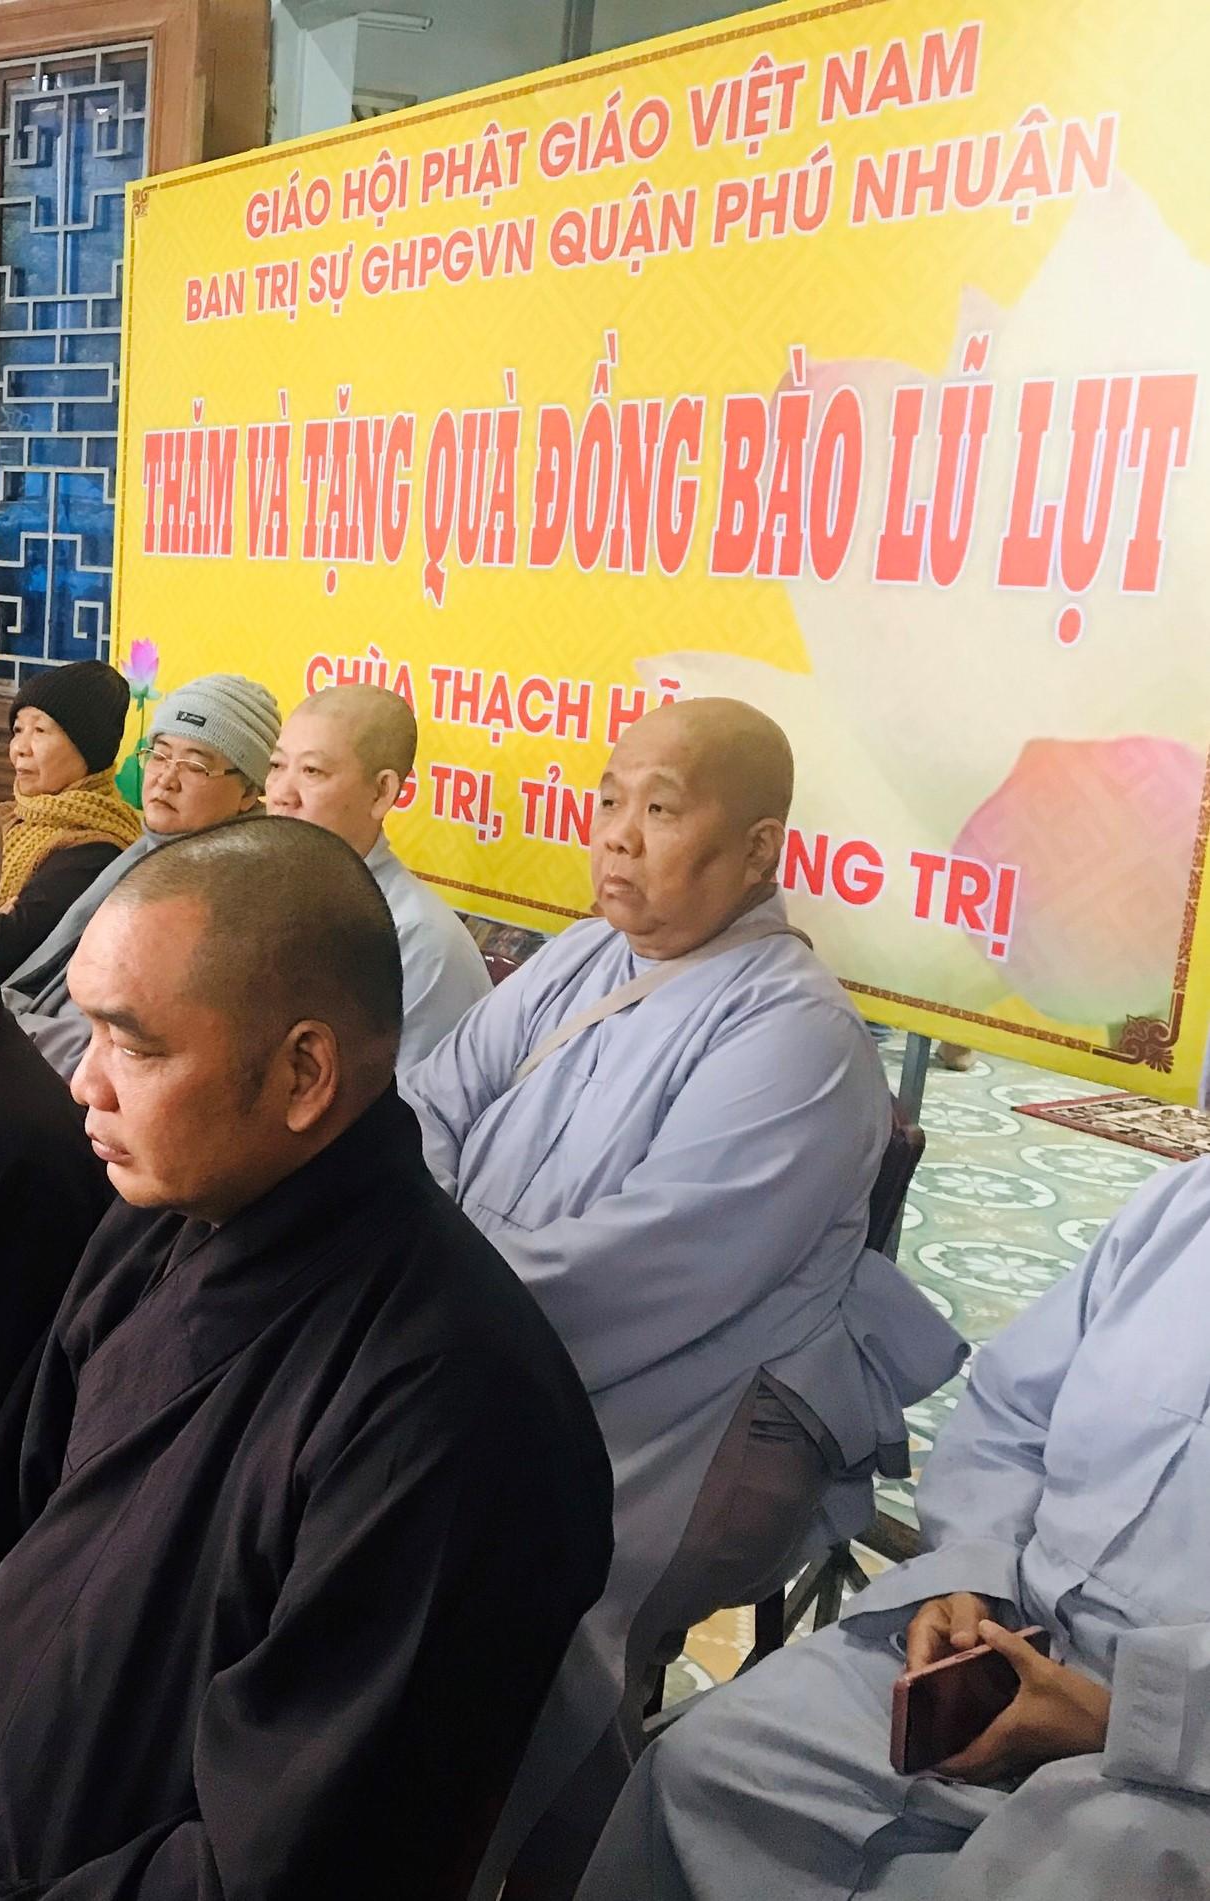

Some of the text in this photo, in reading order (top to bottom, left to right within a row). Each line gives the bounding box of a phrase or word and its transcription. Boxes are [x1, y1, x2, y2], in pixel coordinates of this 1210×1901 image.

[185, 106, 1118, 323] BAN TRỊ SỰ GHPGVN QUẬN PHÚ NHUẬN
[244, 23, 981, 240] GIÁO HỘI PHẬT GIÁO VIỆT NAM
[143, 329, 1200, 646] THĂM VÀ TẶNG QUÀ ĐỒNG BÀO LŨ LỤT
[429, 666, 592, 745] THẠCH
[430, 764, 503, 842] TRỊ,
[520, 763, 594, 848] TỈN
[909, 850, 1018, 958] TRỊ
